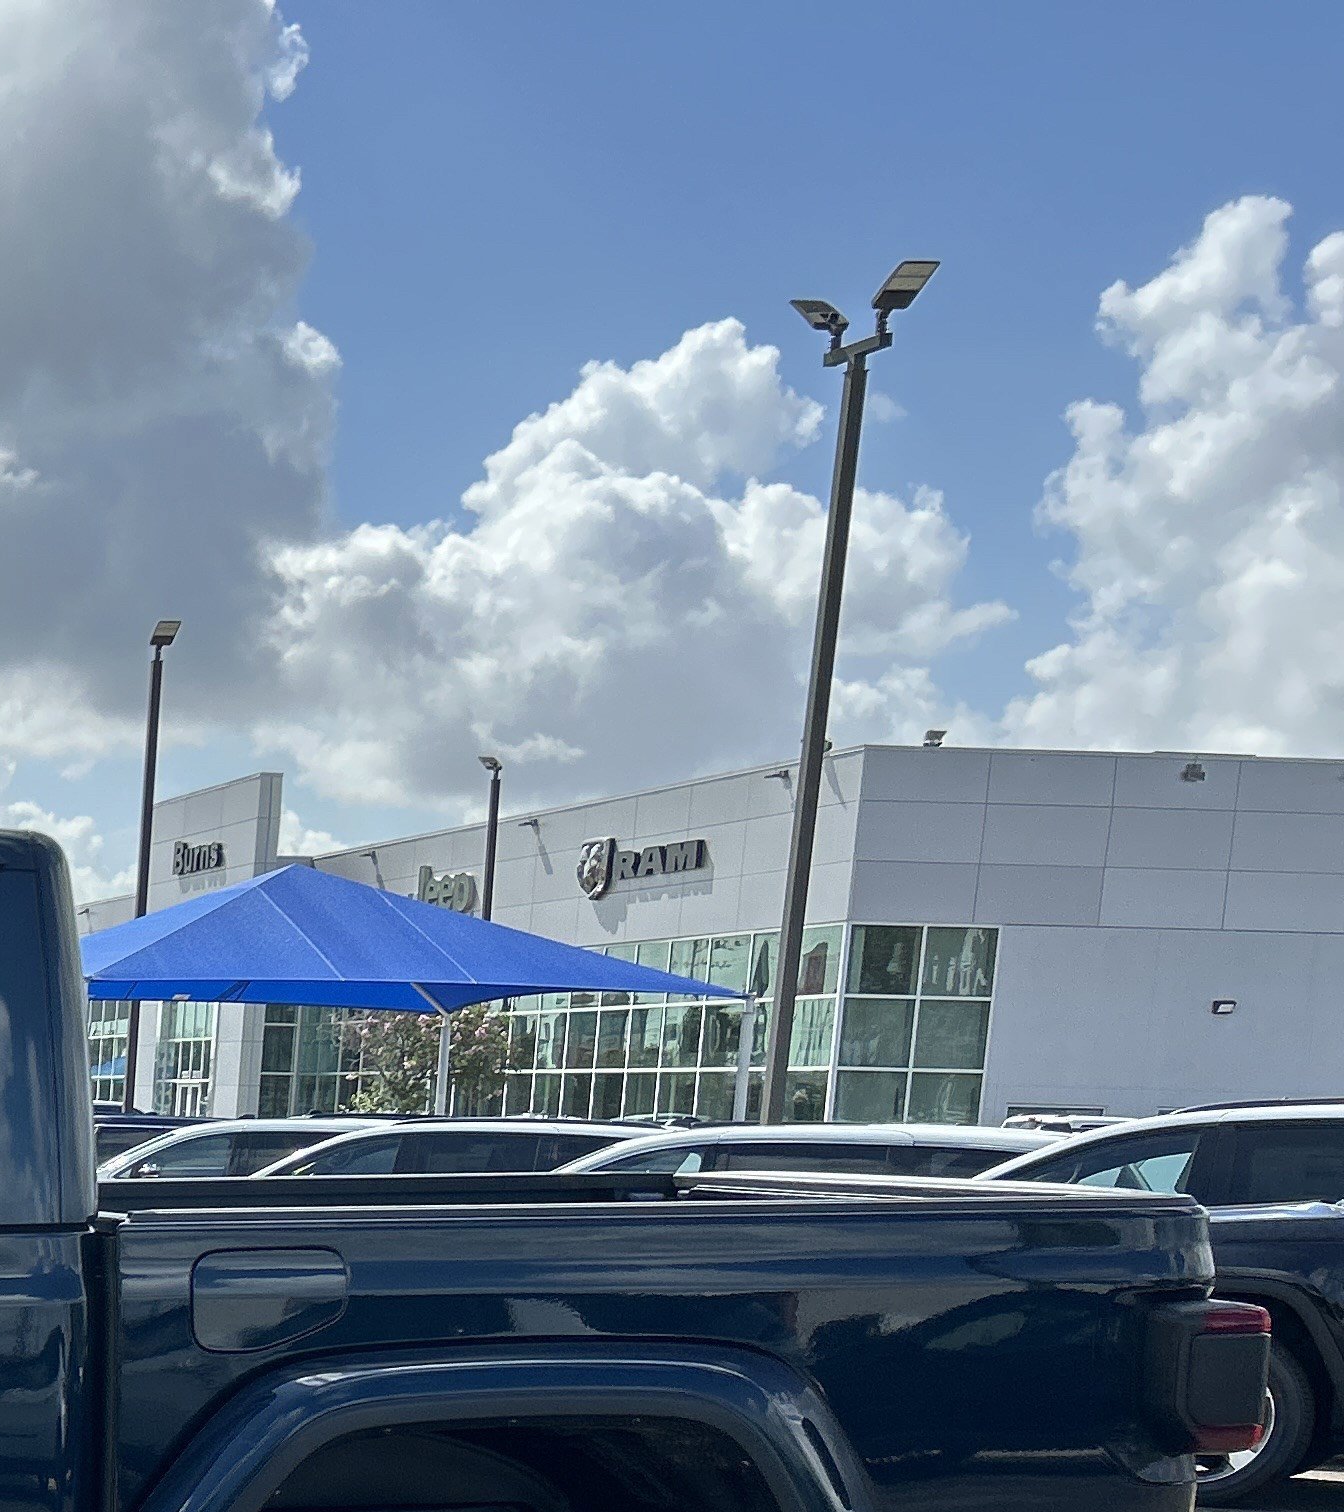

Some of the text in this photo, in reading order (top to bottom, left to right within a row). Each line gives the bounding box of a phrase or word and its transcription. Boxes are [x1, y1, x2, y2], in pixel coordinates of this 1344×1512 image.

[172, 840, 226, 875] Burns
[613, 839, 705, 881] RAM
[415, 865, 479, 914] Jeep
